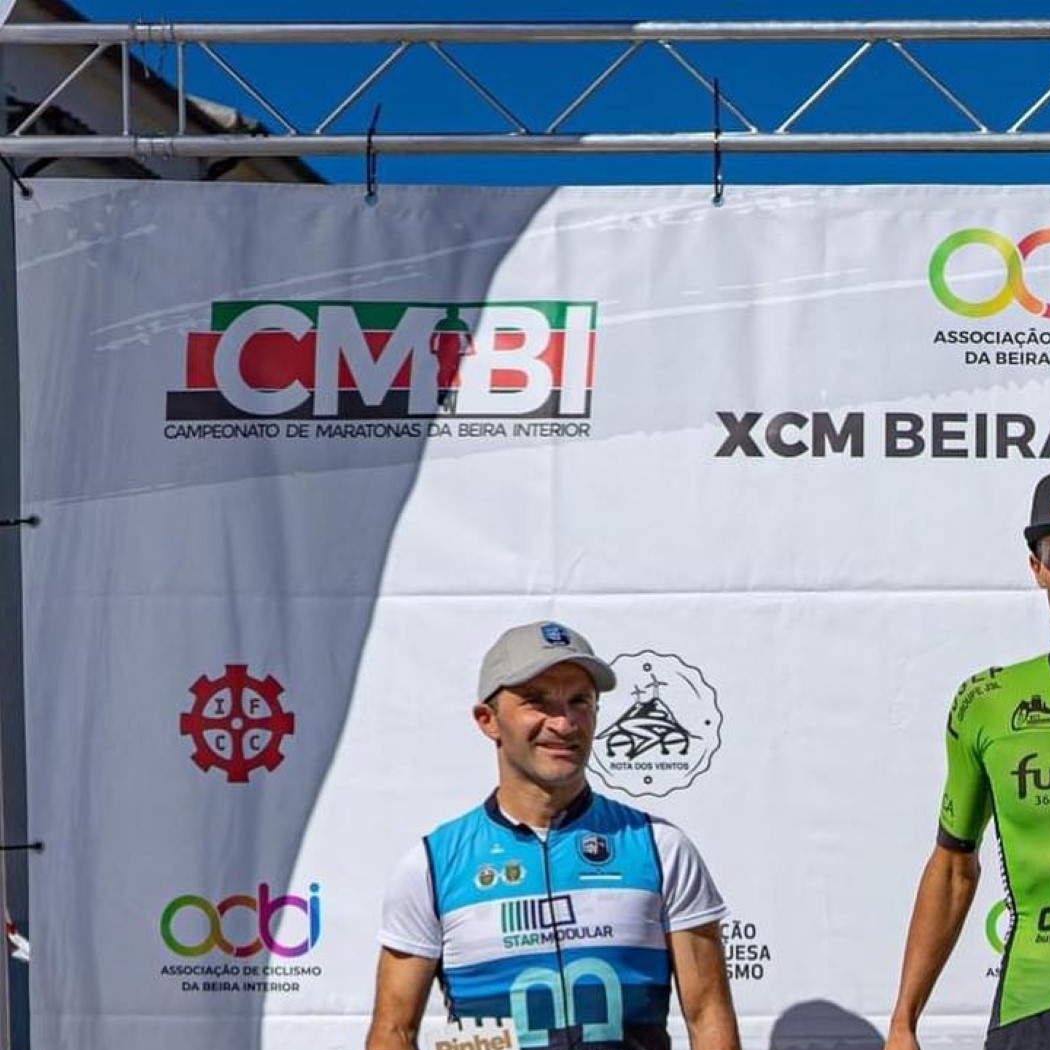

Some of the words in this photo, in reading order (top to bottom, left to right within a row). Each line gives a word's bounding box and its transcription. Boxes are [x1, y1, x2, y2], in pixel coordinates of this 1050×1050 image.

[213, 303, 592, 417] CMBI
[964, 351, 991, 365] DA
[996, 351, 1050, 365] BEIRA
[163, 422, 280, 439] CAMPEONATO
[286, 422, 310, 438] DE
[315, 422, 422, 438] MARATONAS
[427, 422, 452, 438] DA
[457, 422, 508, 438] BEIRA
[512, 422, 591, 438] INTERIOR
[714, 411, 865, 458] XCM
[609, 762, 633, 771] ROTA
[635, 762, 653, 771] DOS
[655, 762, 690, 771] VENTOS
[503, 926, 613, 949] STARMODULAR
[161, 964, 240, 977] ASSOCIAÇÃO
[243, 965, 257, 976] DE
[262, 965, 322, 976] CICLISMO
[182, 981, 199, 992] DA
[202, 981, 240, 992] BEIRA
[243, 981, 300, 992] INTERIOR
